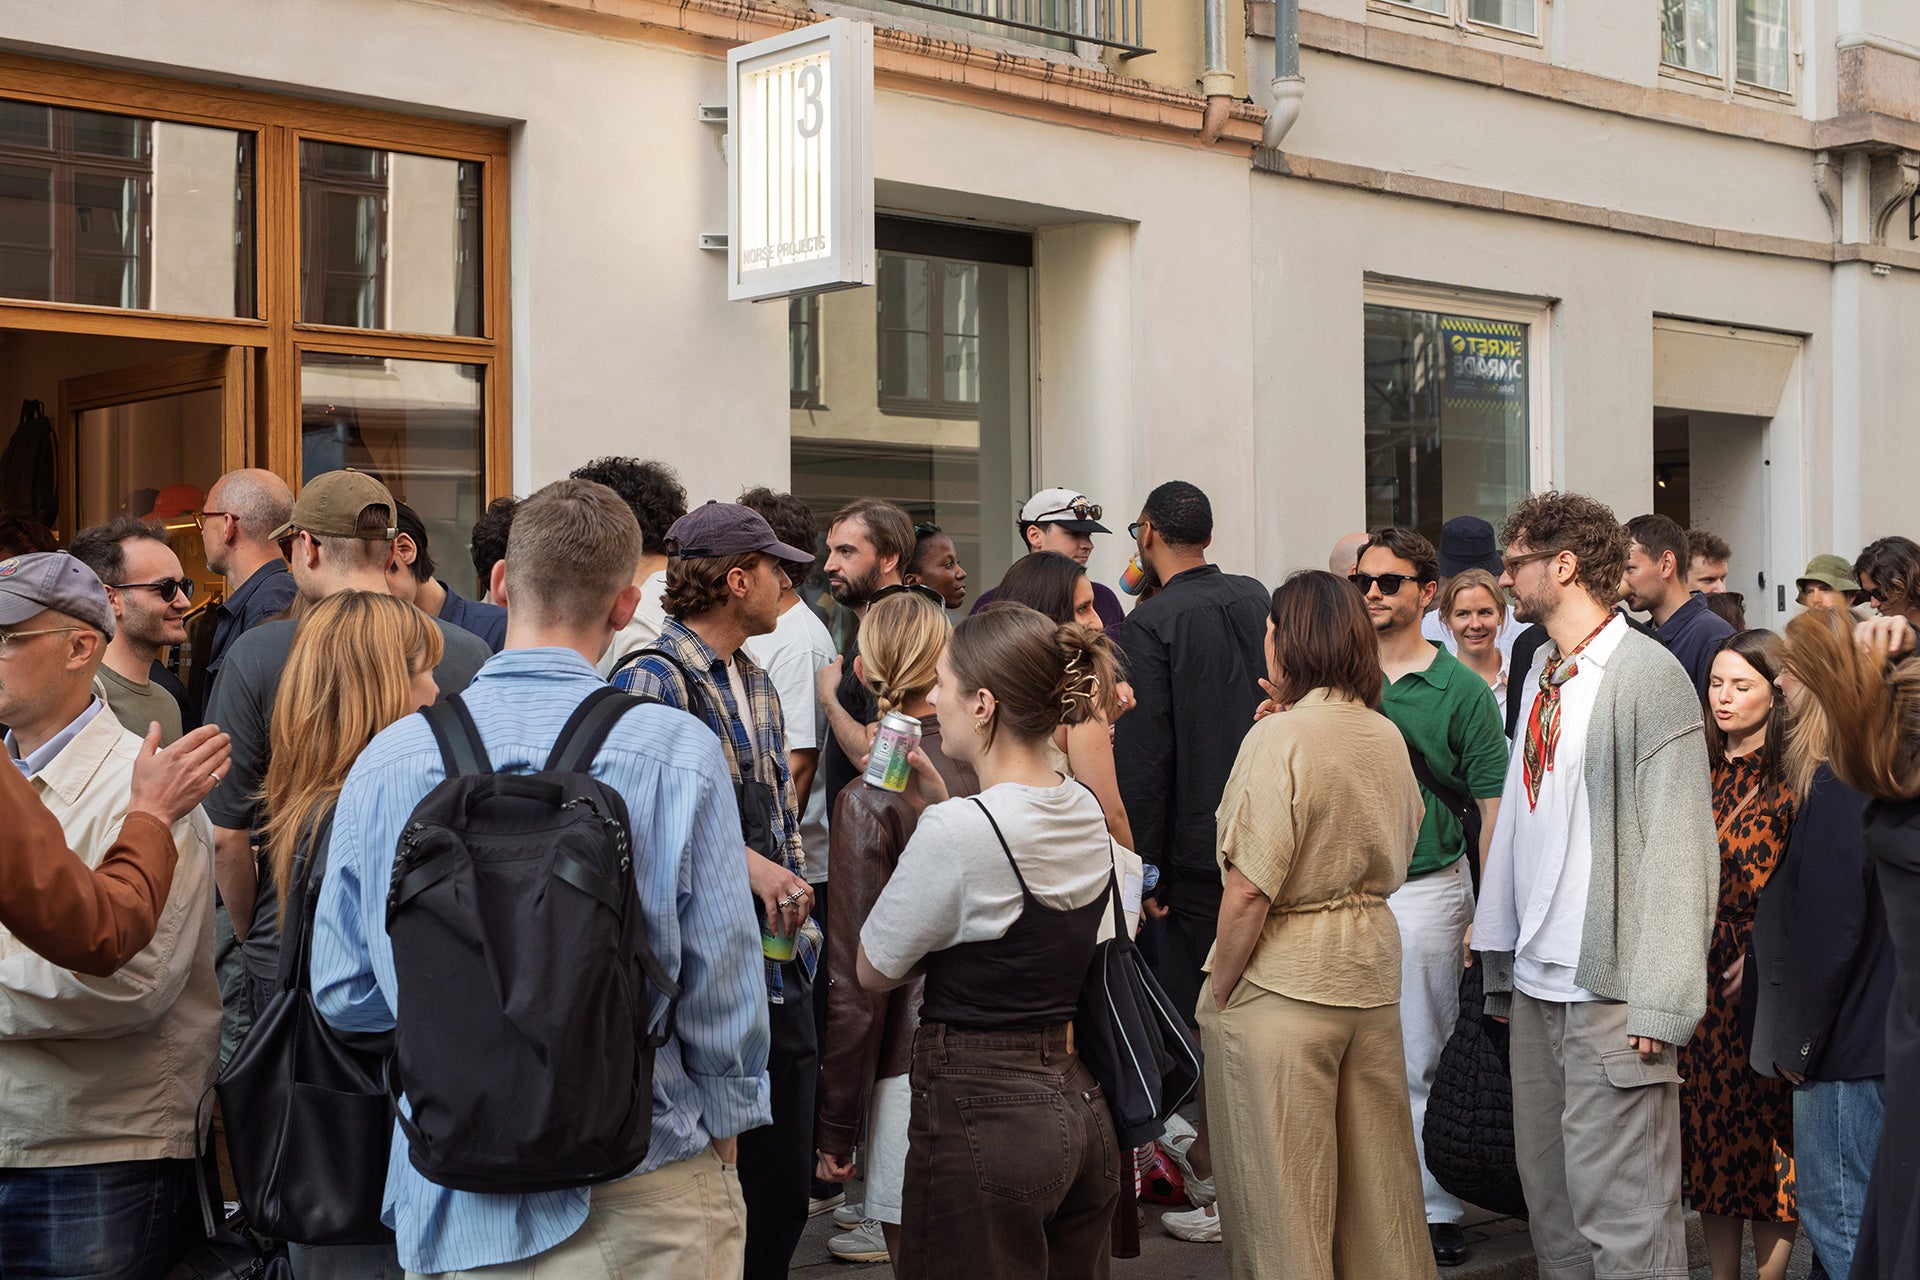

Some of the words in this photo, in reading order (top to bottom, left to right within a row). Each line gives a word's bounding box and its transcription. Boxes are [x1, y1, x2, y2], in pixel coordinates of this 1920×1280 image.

[798, 65, 823, 138] 3
[743, 245, 774, 264] NORSE
[777, 235, 825, 257] PROJECTS
